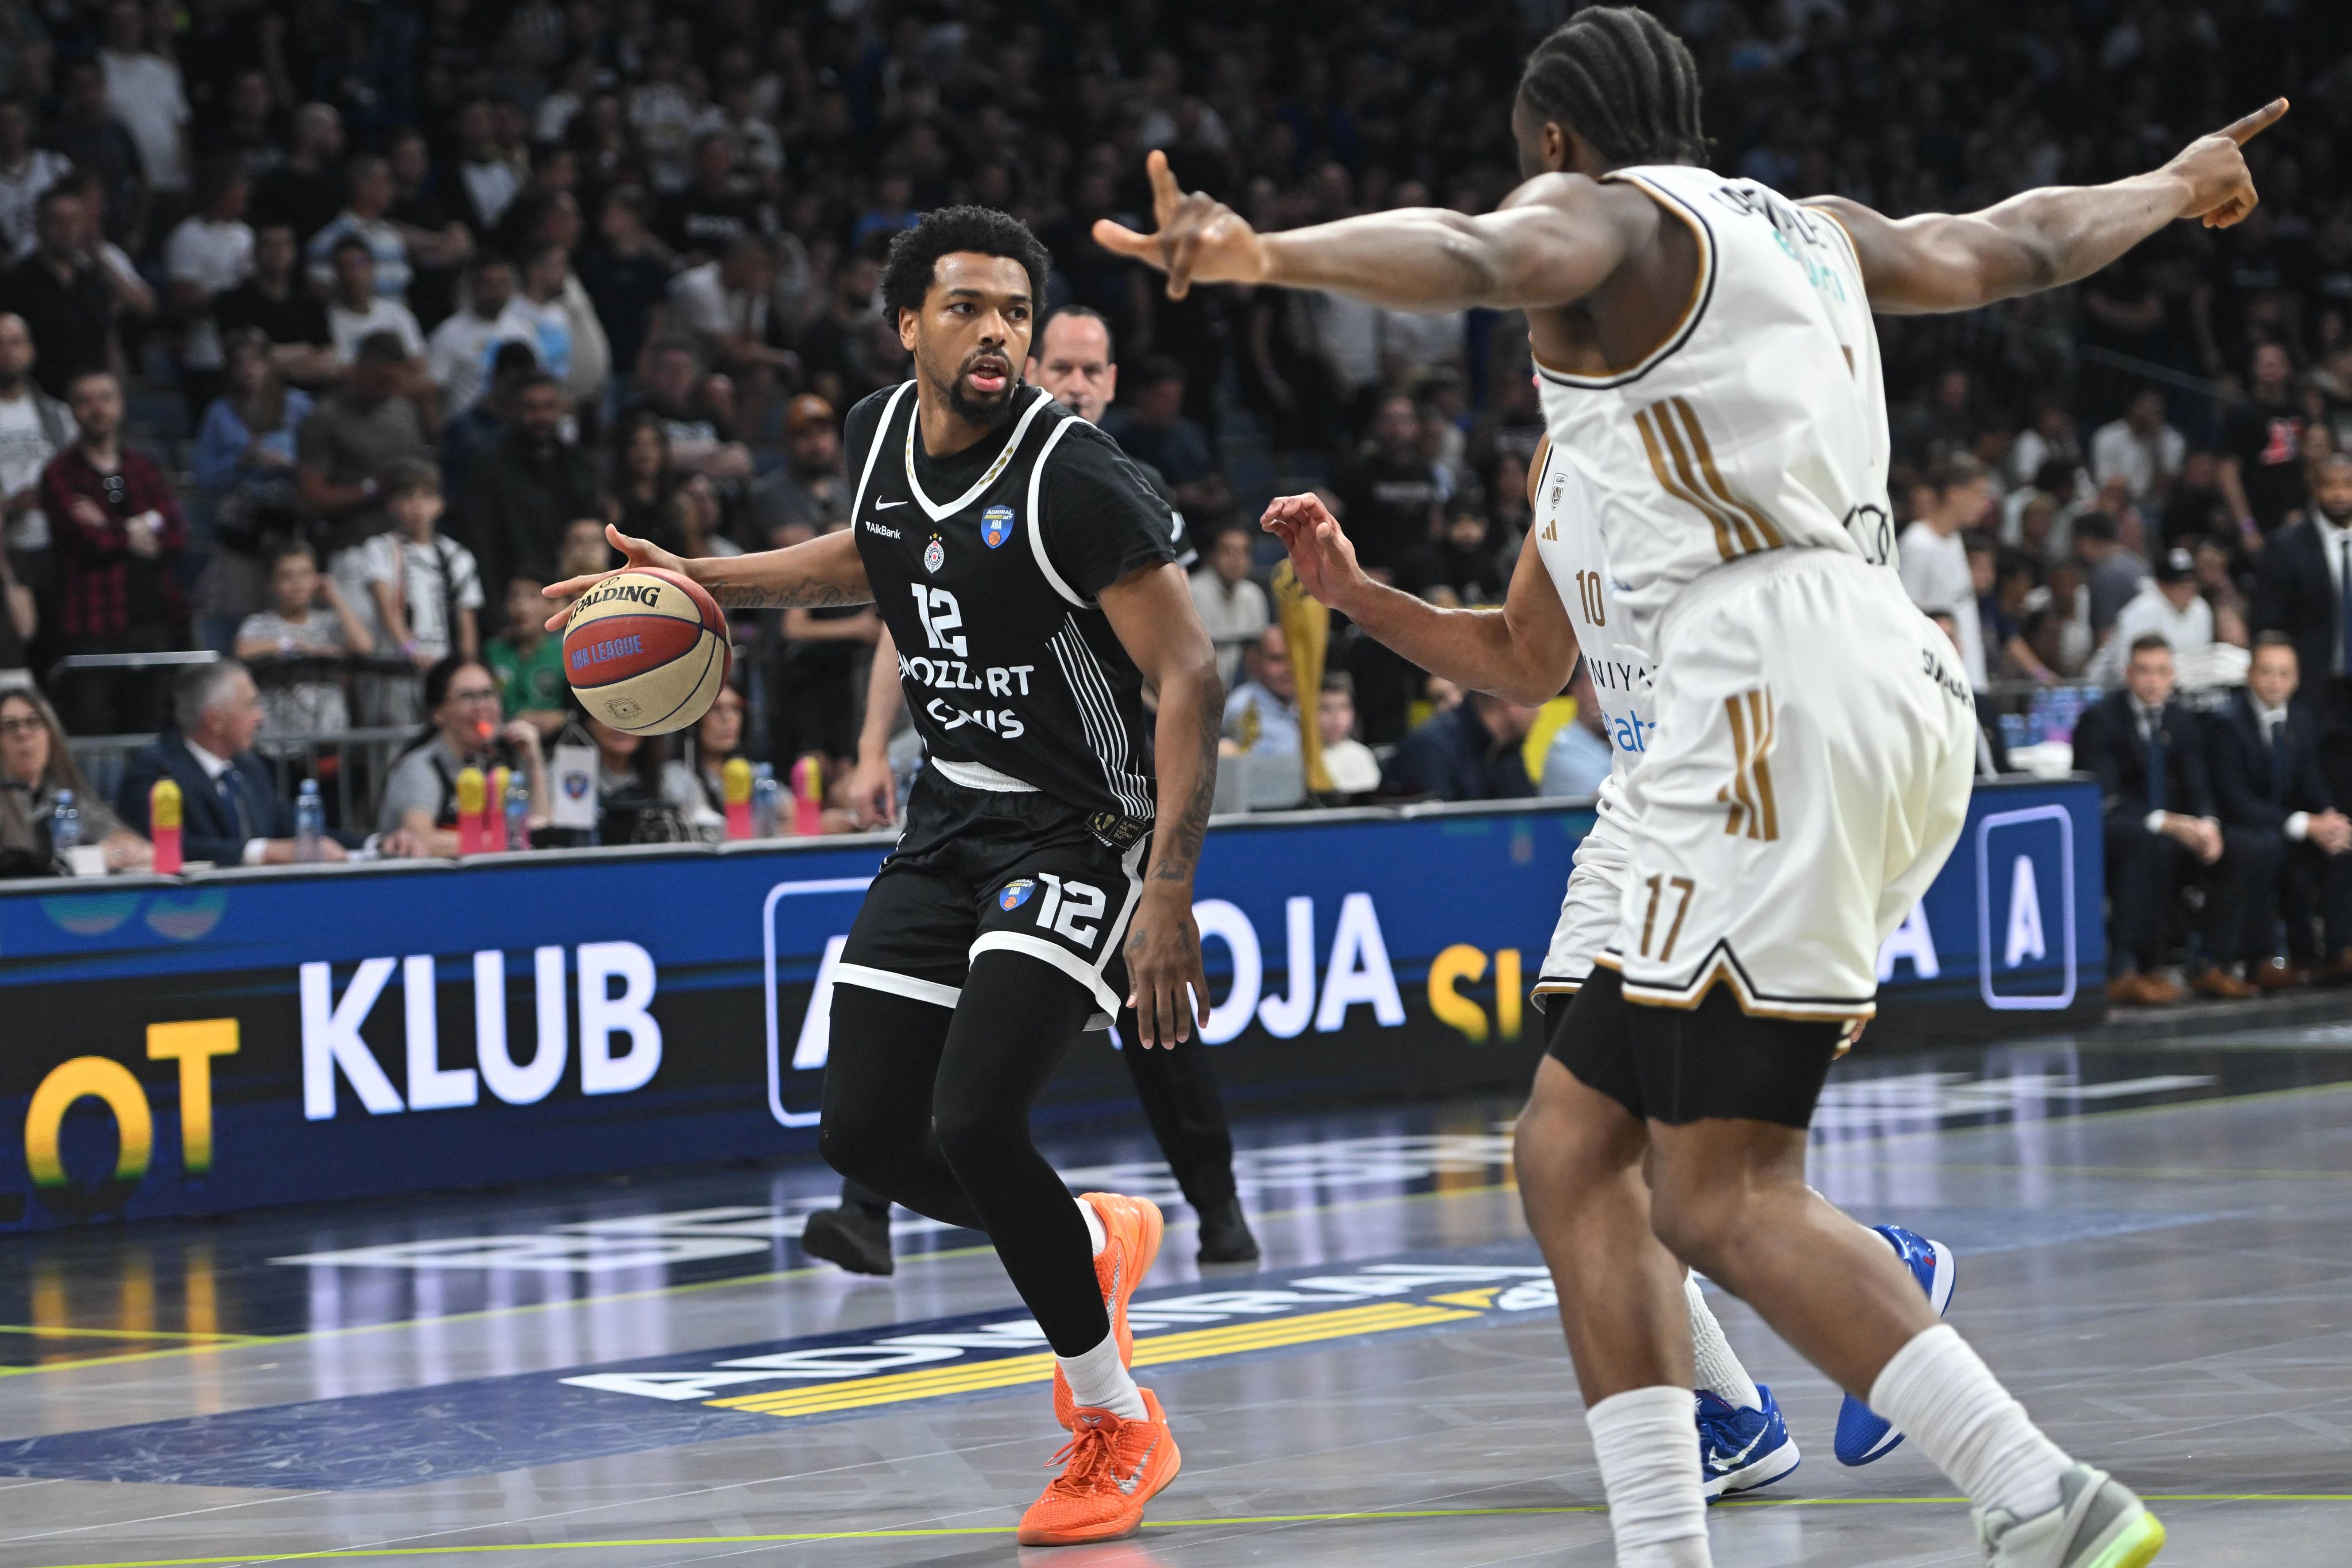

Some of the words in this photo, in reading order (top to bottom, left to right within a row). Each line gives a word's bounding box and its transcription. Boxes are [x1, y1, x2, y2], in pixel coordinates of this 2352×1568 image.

[870, 522, 901, 540] AikBank
[991, 520, 1002, 529] ABA
[911, 582, 968, 657] 12
[1576, 569, 1606, 627] 10
[591, 634, 644, 664] LEAGUE
[897, 649, 1035, 697] MOZZRT
[1035, 872, 1107, 950] 12
[1640, 872, 1696, 963] 17
[1160, 891, 1407, 1047] OJA
[24, 1017, 240, 1200] OT
[299, 940, 663, 1120] KLUB
